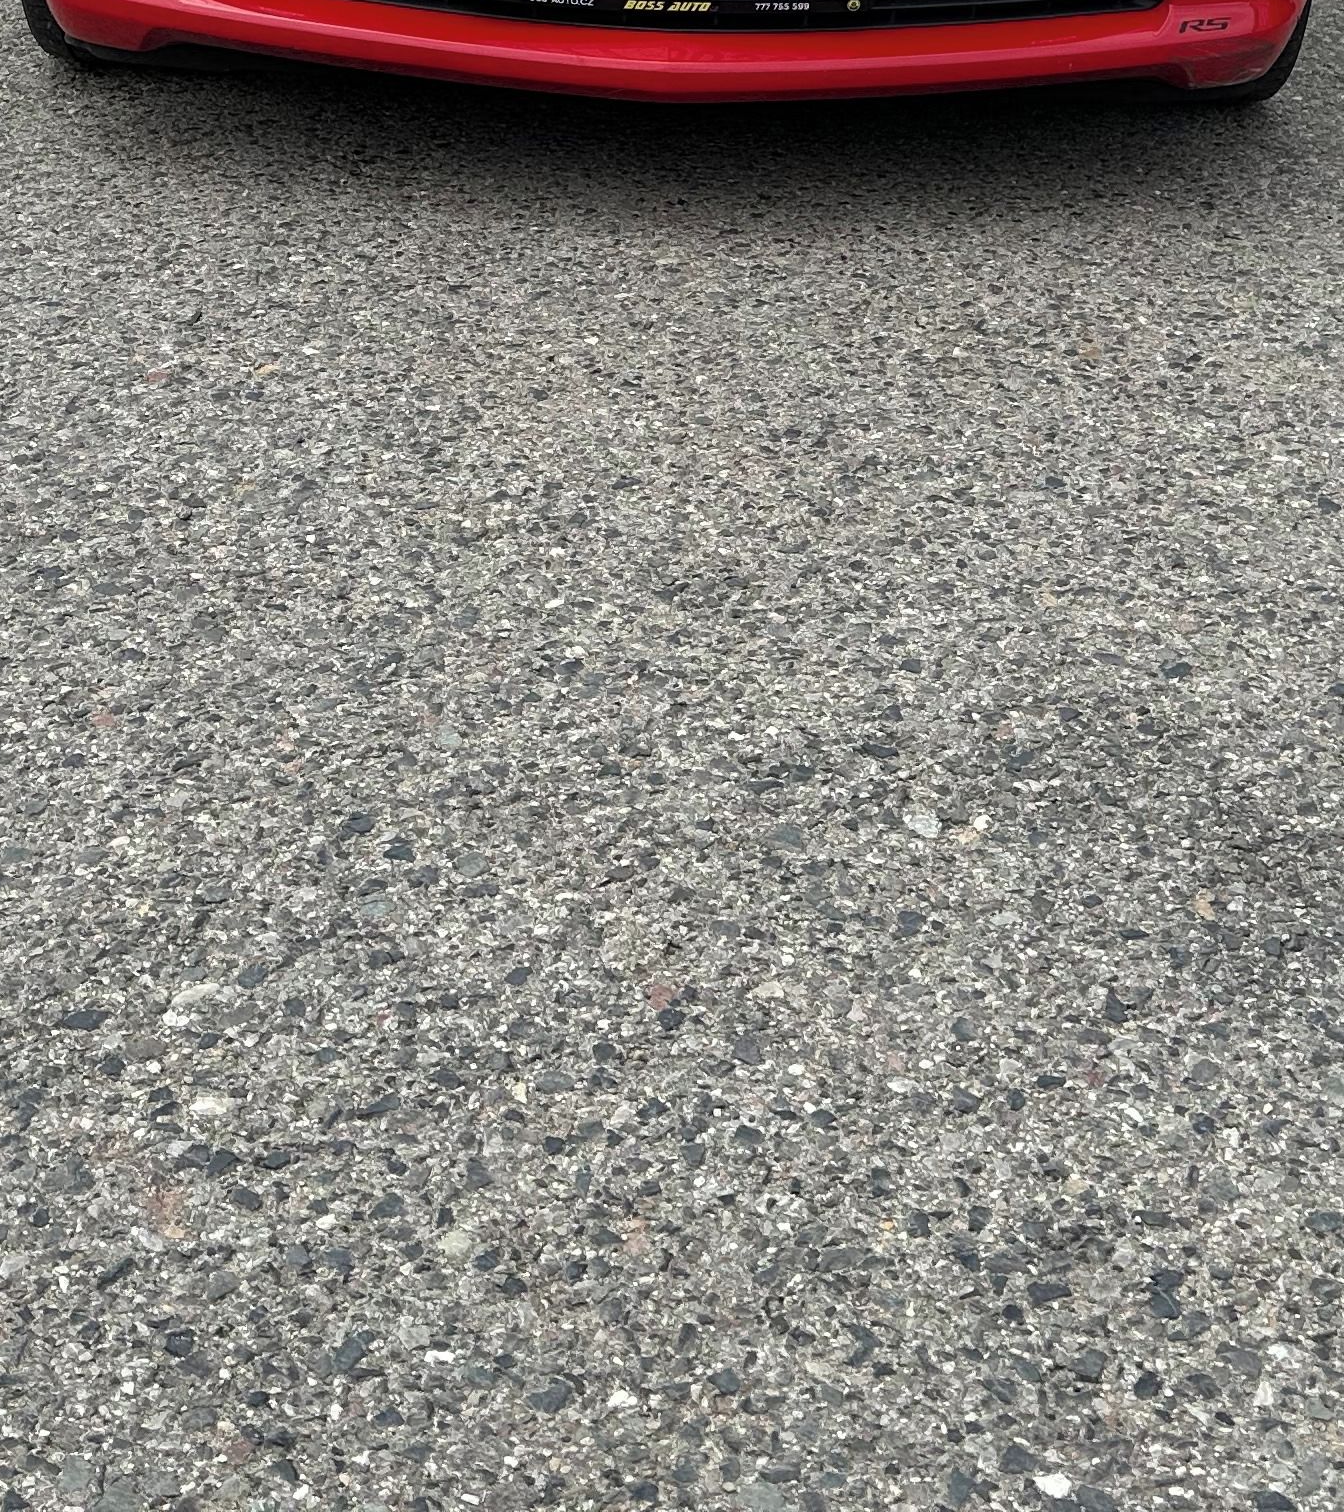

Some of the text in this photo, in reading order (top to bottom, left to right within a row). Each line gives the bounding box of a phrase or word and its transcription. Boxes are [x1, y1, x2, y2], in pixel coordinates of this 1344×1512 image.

[623, 0, 712, 12] BOSS AUTO
[755, 2, 771, 11] 777
[1179, 16, 1233, 34] RS
